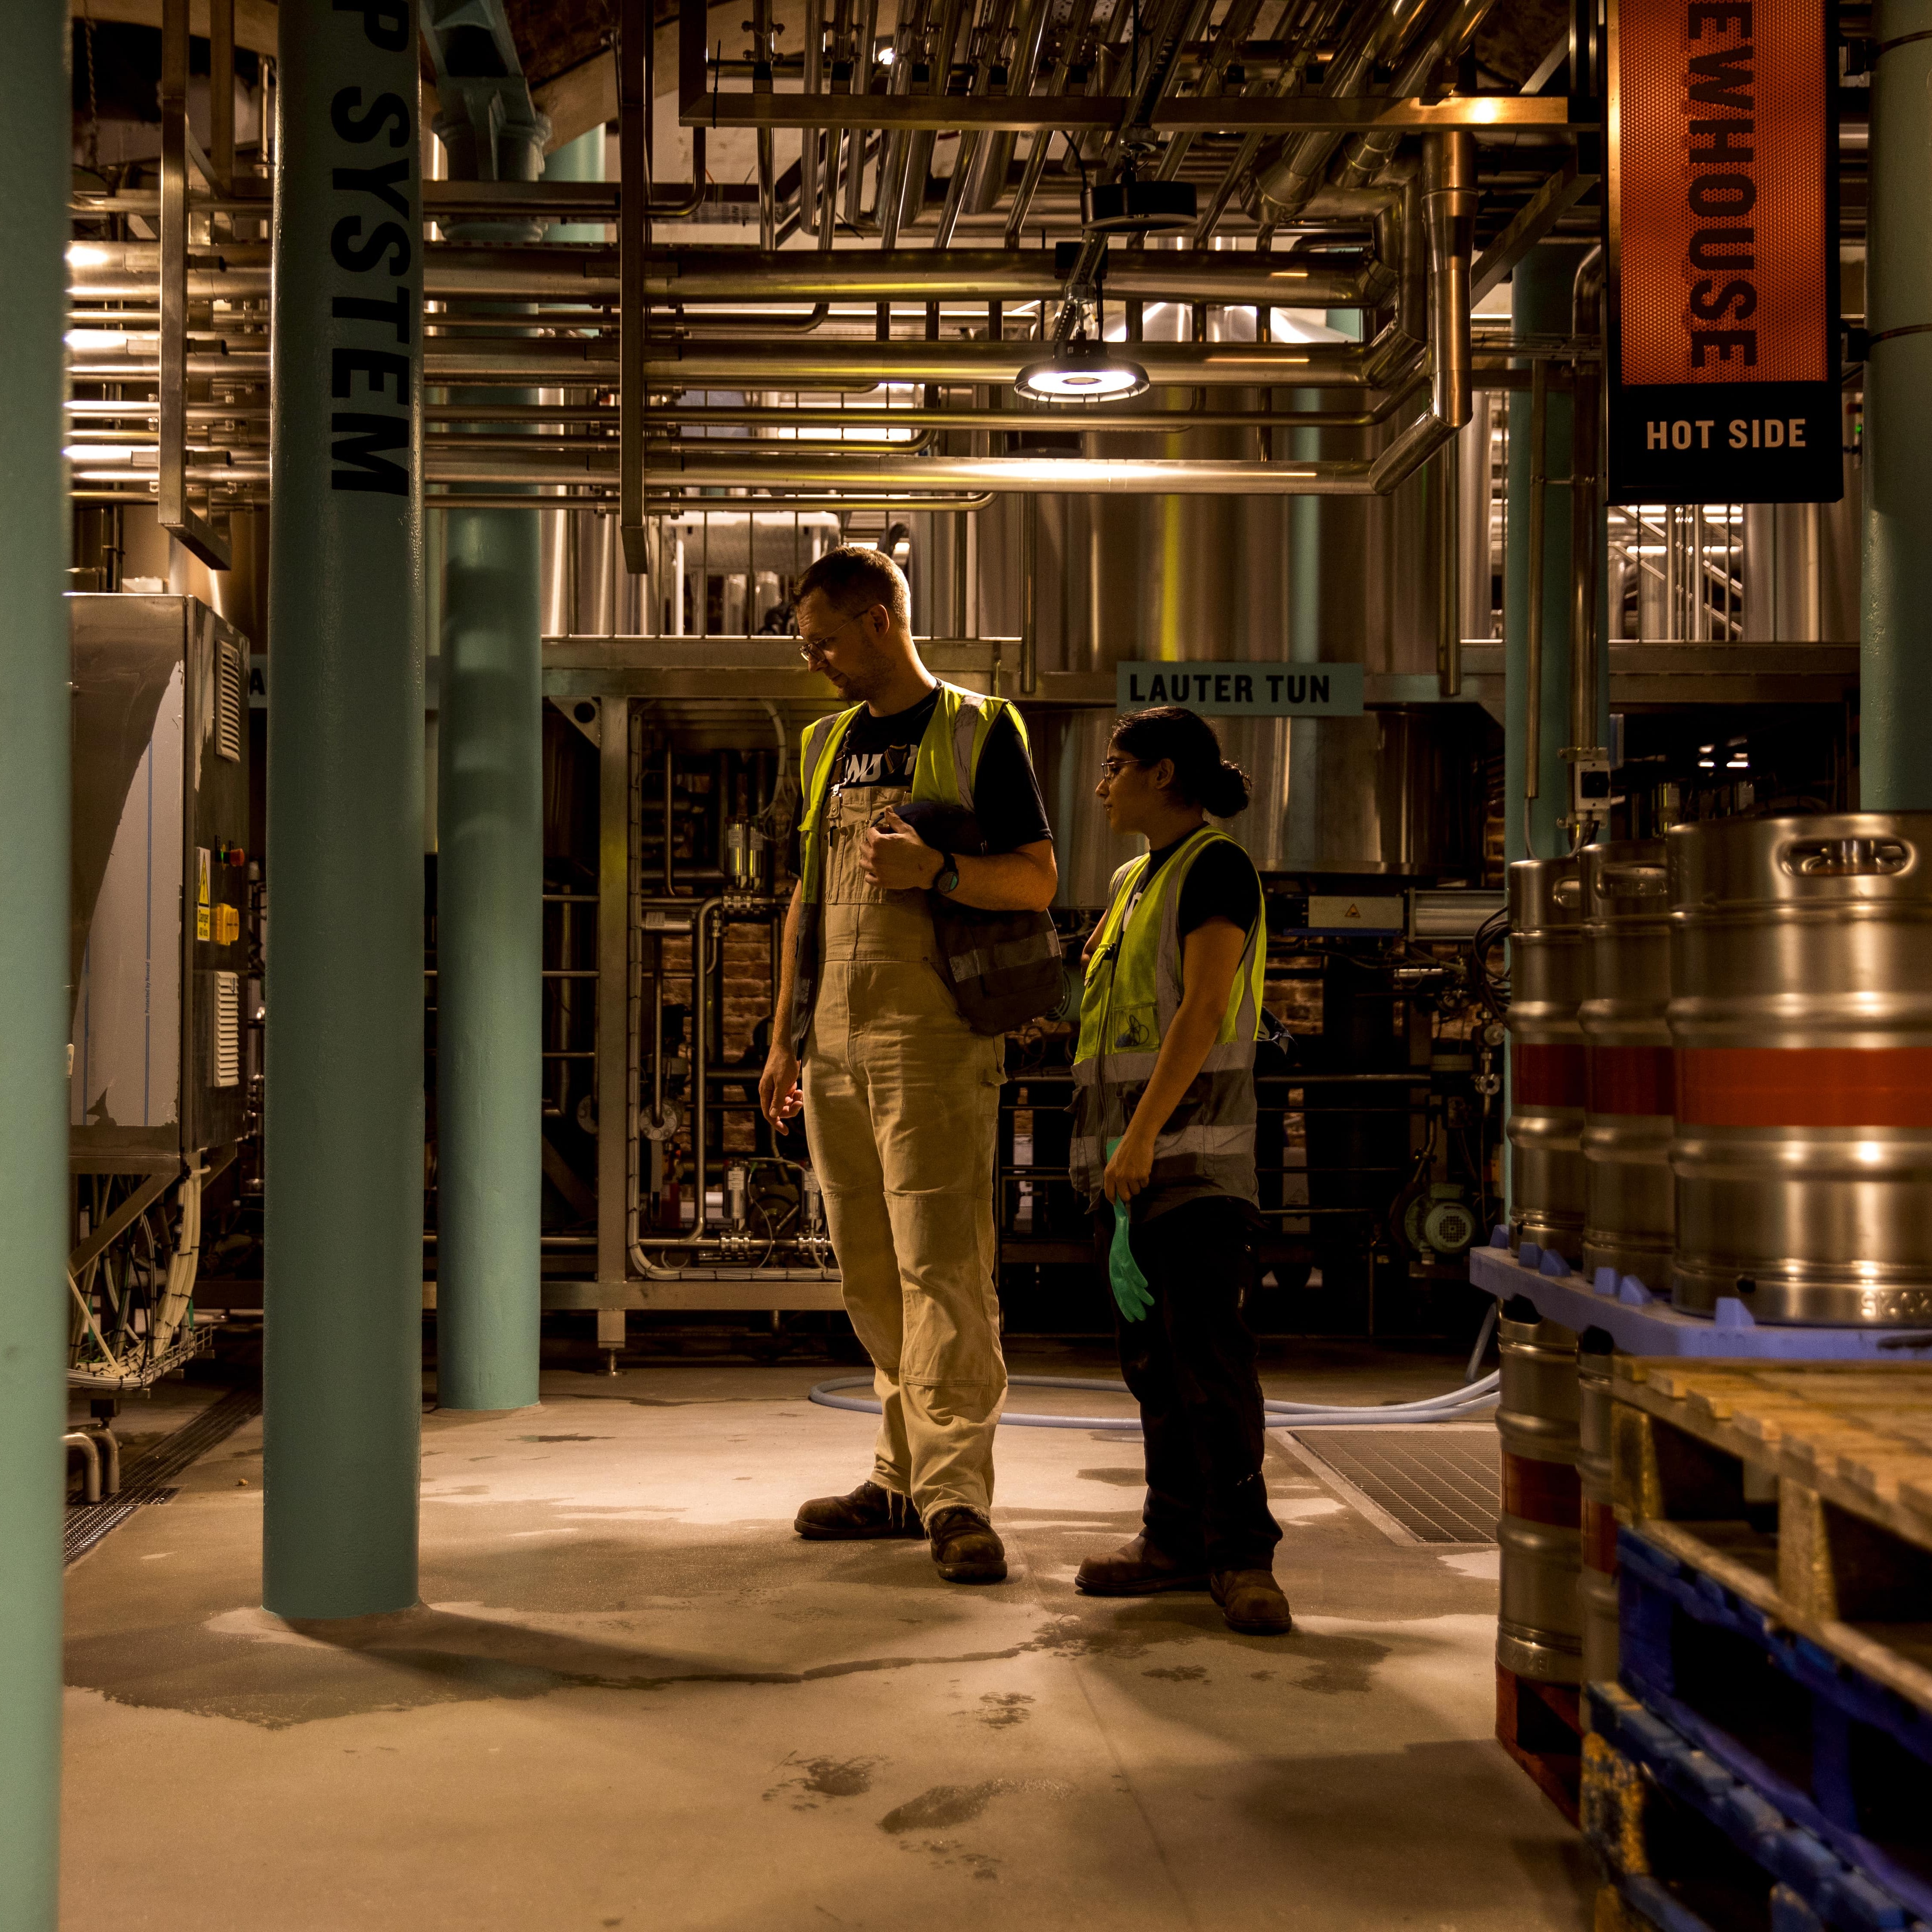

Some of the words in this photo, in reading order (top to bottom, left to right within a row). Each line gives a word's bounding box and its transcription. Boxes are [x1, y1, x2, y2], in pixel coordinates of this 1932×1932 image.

[1688, 3, 1757, 367] EWHOUSE
[330, 86, 411, 496] SYSTEM
[1647, 420, 1715, 450] HOT
[1728, 418, 1806, 448] SIDE
[1129, 674, 1253, 702] LAUTER
[1266, 674, 1330, 703] TUN
